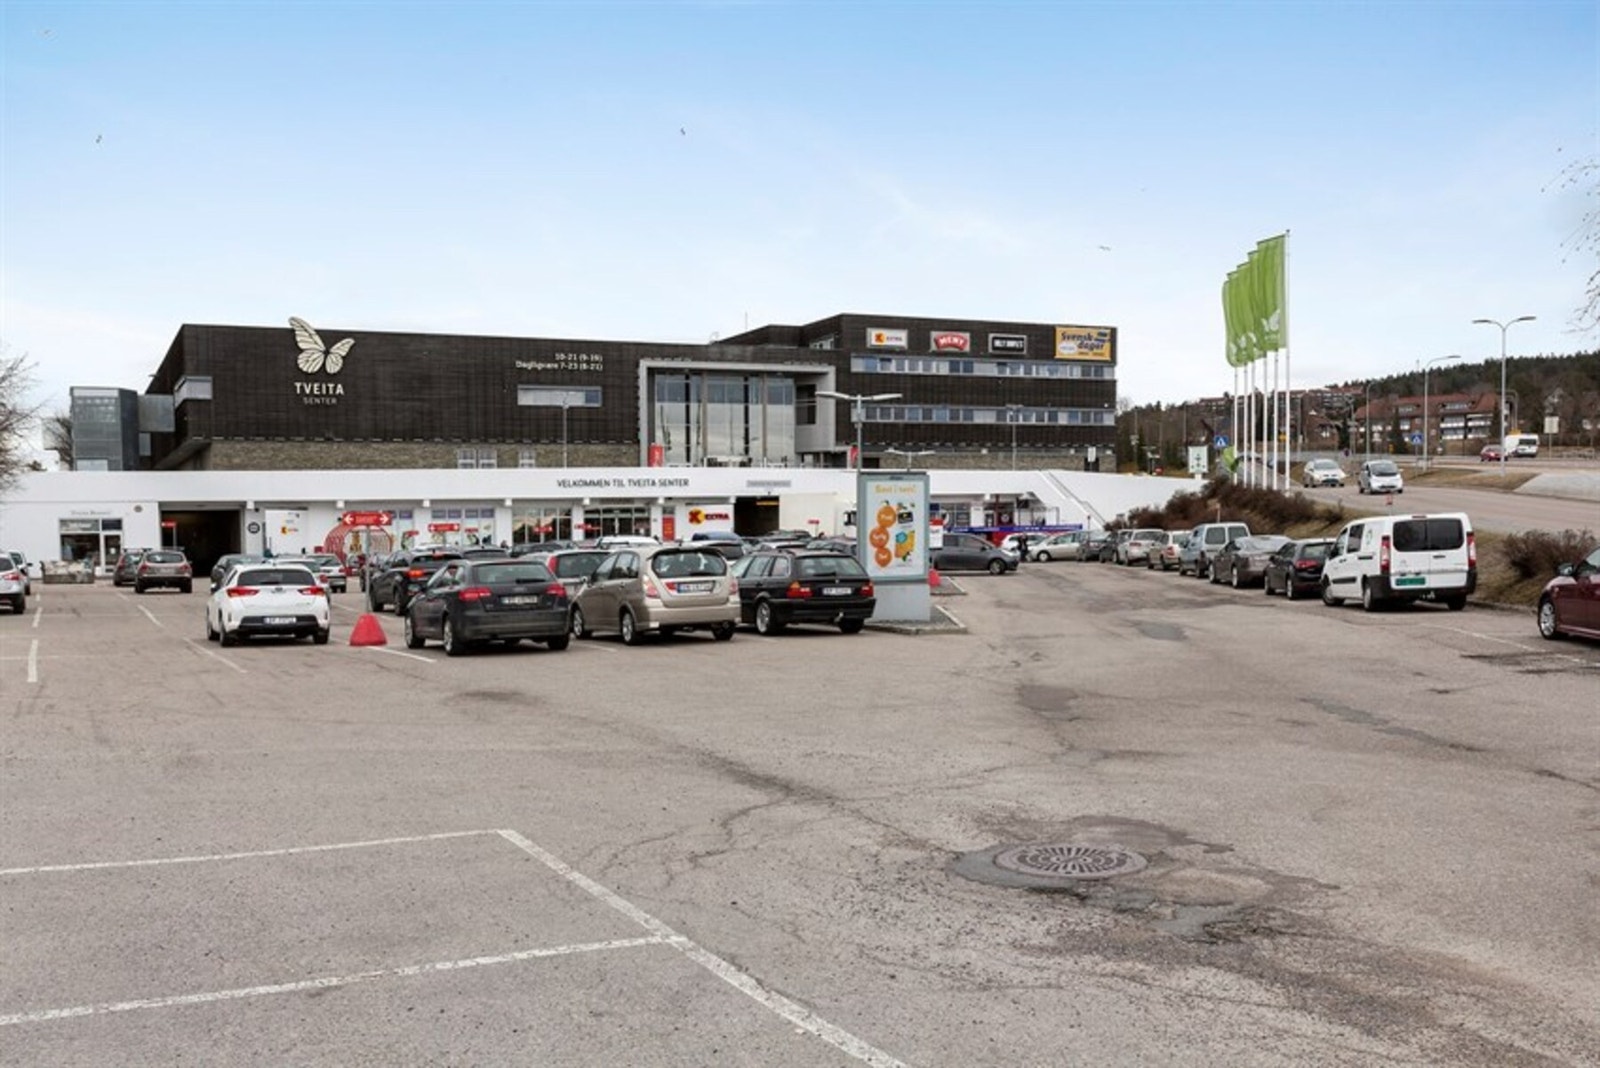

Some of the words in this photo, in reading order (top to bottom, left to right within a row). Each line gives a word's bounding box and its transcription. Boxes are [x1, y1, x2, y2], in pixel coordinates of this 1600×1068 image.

[939, 335, 965, 346] MENY
[294, 382, 344, 395] TVEITA
[303, 397, 337, 405] SENTER
[556, 478, 611, 488] VELKOMMEN
[612, 478, 626, 488] TIL
[628, 478, 657, 488] TVEITA
[658, 478, 690, 488] SENTER
